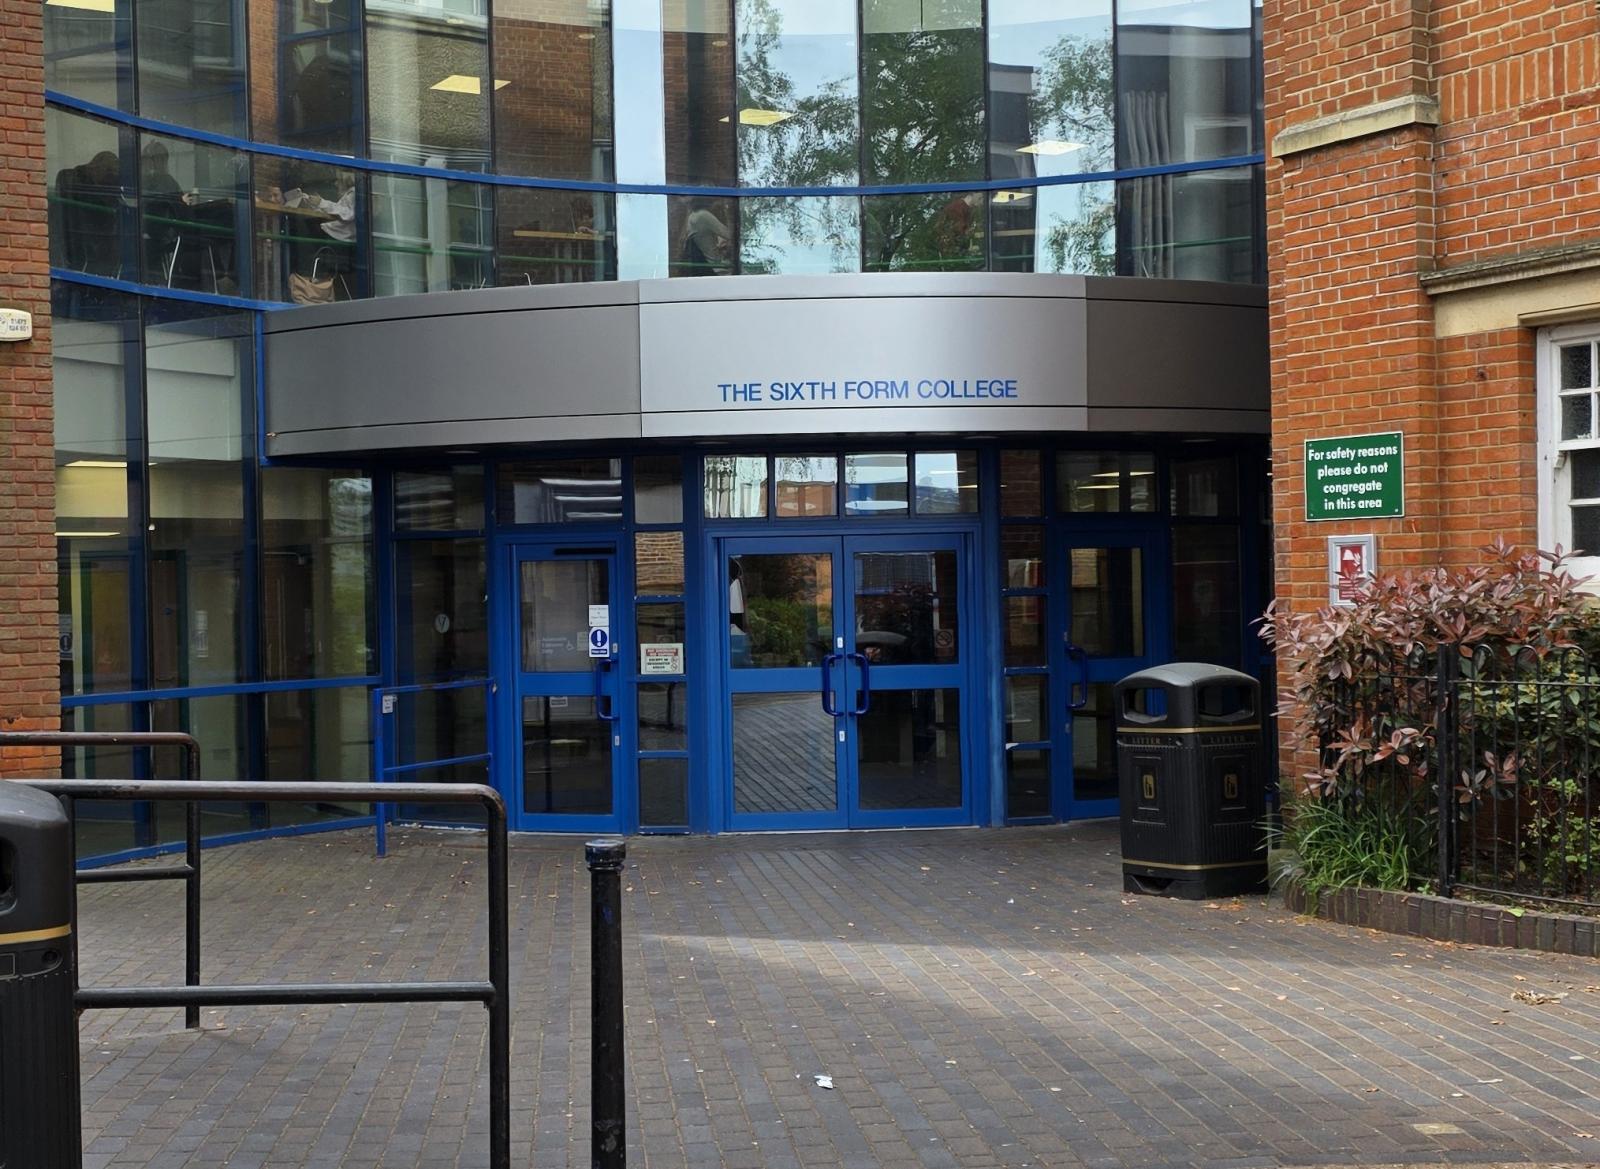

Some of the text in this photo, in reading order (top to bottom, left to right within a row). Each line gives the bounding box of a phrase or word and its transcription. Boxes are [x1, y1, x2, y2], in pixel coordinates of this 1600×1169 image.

[718, 379, 1017, 402] THE SIXTH FORM COLLEGE
[1308, 446, 1398, 463] For safety reasons
[1317, 461, 1389, 481] please do not
[1323, 480, 1383, 496] congregate
[1324, 497, 1383, 511] in this area
[1132, 736, 1161, 744] LITTER
[1210, 735, 1246, 743] LITTER
